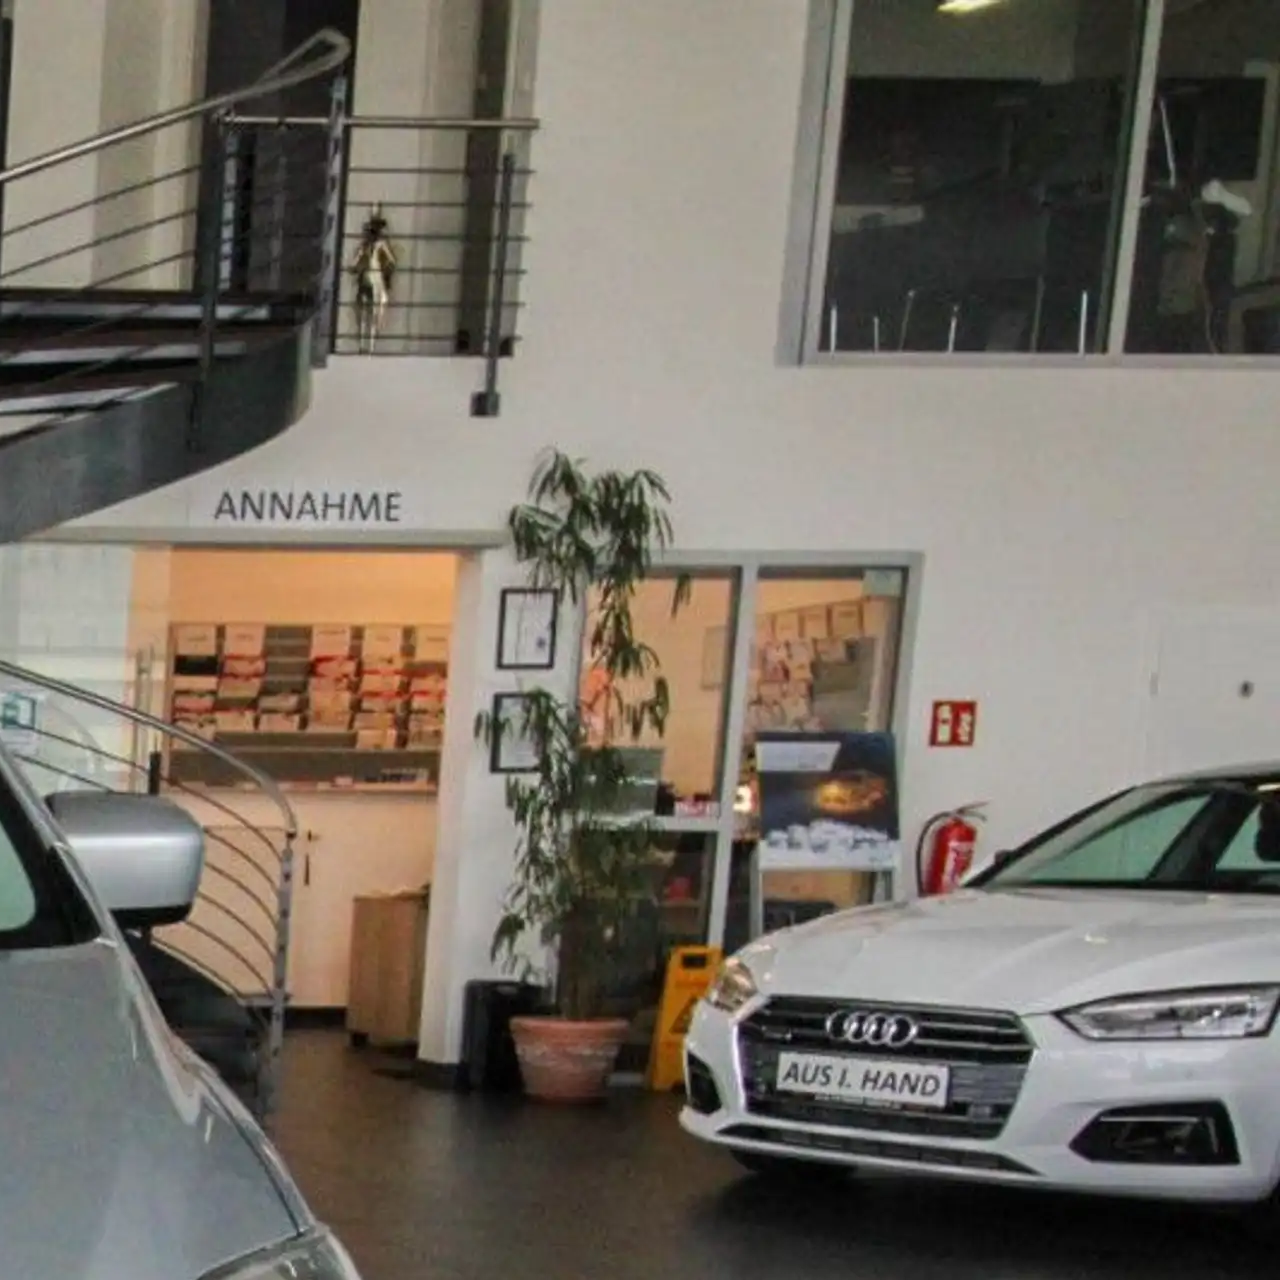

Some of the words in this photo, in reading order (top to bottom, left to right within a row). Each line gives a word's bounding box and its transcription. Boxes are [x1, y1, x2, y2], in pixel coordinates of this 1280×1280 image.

[214, 490, 402, 522] ANNAHME
[783, 1062, 833, 1087] AUS
[860, 1070, 941, 1097] HAND
